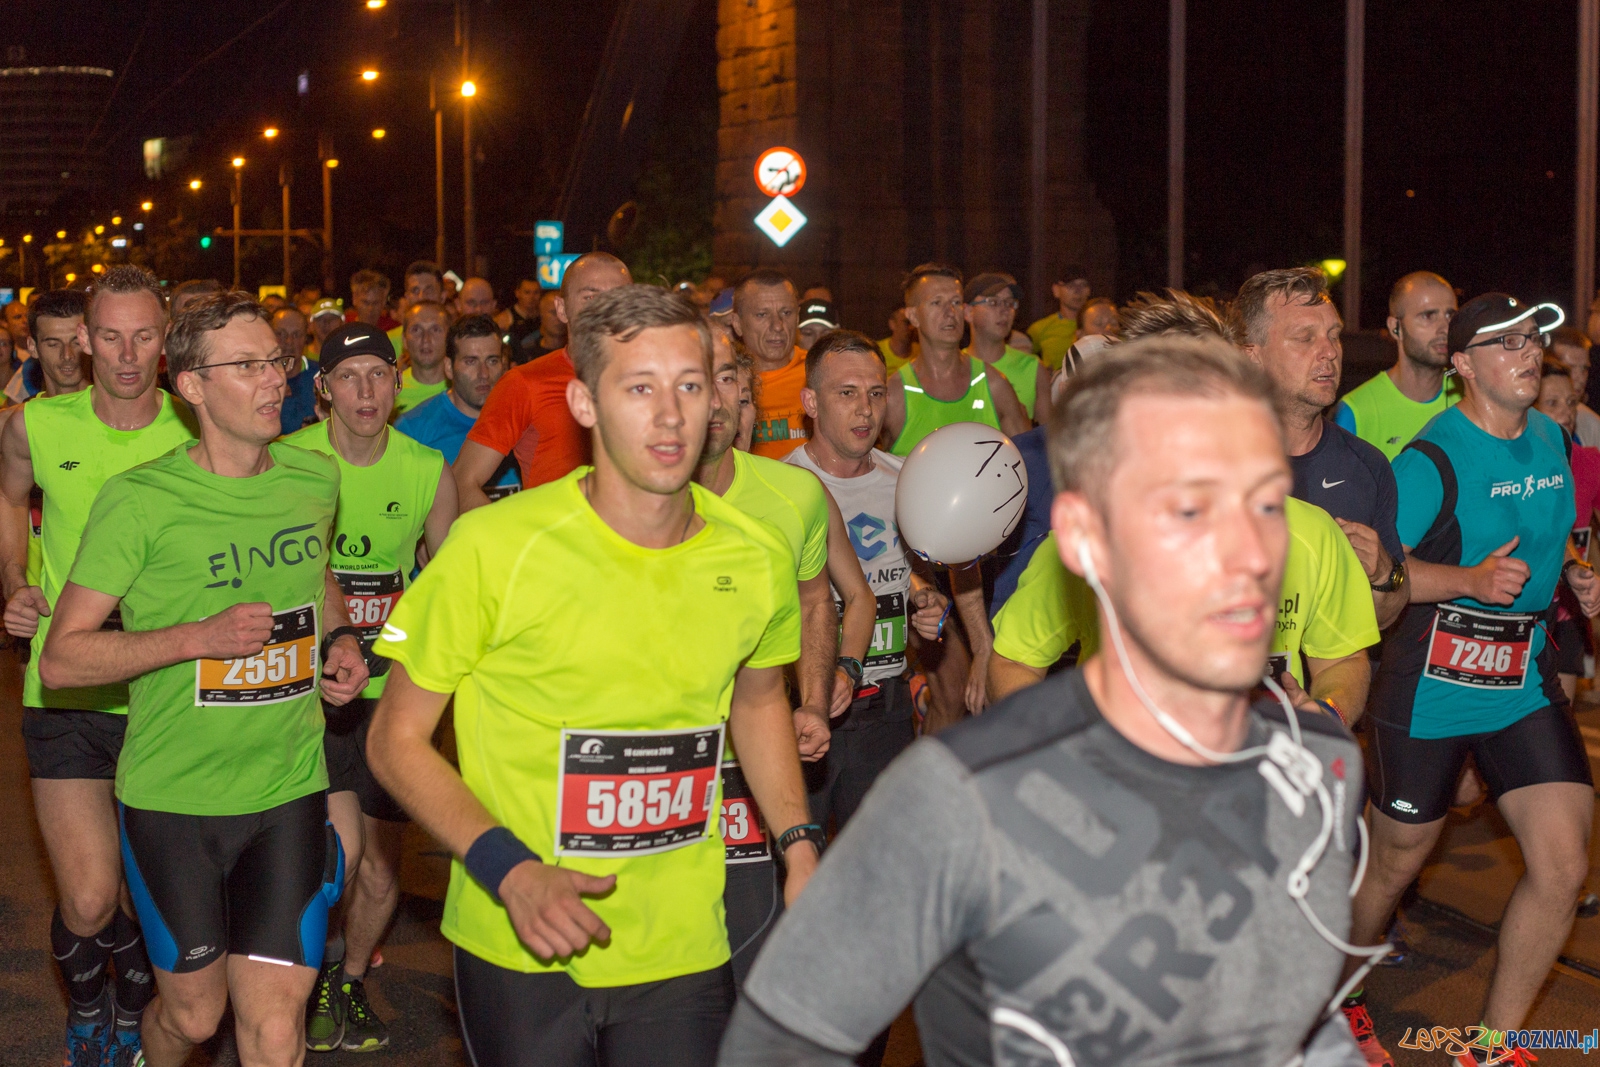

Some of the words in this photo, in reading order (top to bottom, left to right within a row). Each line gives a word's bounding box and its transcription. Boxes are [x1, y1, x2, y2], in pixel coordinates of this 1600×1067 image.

[59, 460, 80, 471] 4F
[1490, 483, 1522, 498] PRO
[1537, 474, 1564, 490] RUN
[222, 644, 298, 685] 2551
[1449, 638, 1513, 673] 7246
[586, 776, 694, 828] 5854
